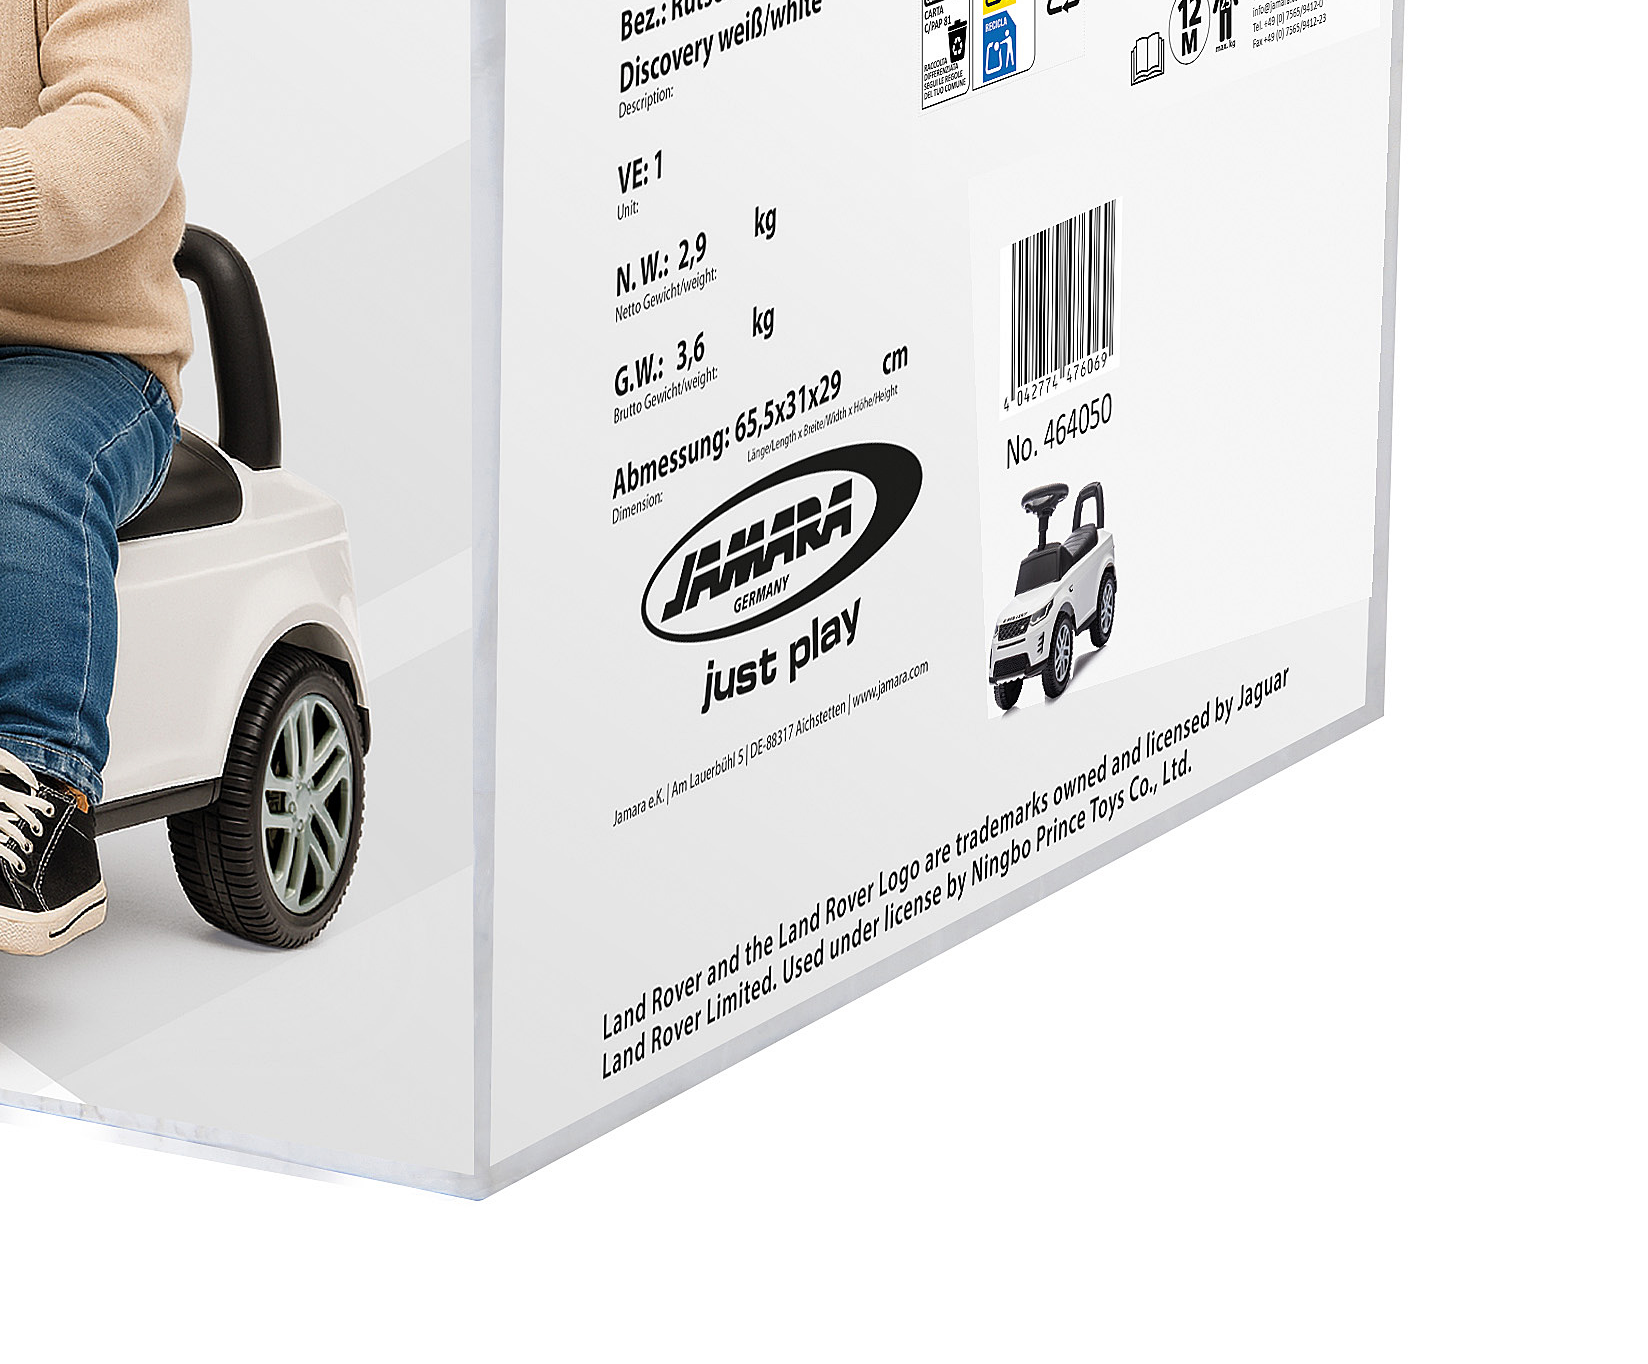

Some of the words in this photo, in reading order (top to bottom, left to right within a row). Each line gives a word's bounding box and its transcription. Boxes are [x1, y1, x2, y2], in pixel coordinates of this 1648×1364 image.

[621, 3, 666, 41] Bez.:
[924, 6, 944, 20] CARTA
[924, 18, 942, 34] C/PAP
[944, 15, 951, 26] 81
[985, 17, 1007, 33] RECICLA
[620, 34, 714, 93] Discovery
[924, 57, 947, 72] RACCOLTA
[1182, 28, 1197, 57] M
[924, 63, 958, 81] DIFFERENZIATA
[924, 91, 932, 100] DEL
[933, 86, 944, 98] TUO
[945, 78, 966, 94] COMUNE
[619, 87, 673, 118] Description:
[618, 157, 648, 194] VE:
[655, 150, 661, 179] 1
[618, 200, 638, 220] Unit:
[617, 263, 636, 297] N.
[641, 250, 668, 285] W.:
[679, 232, 706, 270] 2,9
[754, 206, 777, 240] kg
[616, 302, 641, 323] Netto
[643, 268, 716, 310] Gewicht/weight:
[615, 353, 663, 396] G.W.:
[677, 331, 704, 370] 3,6
[753, 306, 775, 340] kg
[883, 346, 907, 375] cm
[614, 402, 642, 424] Brutto
[644, 367, 717, 409] Gewicht/weight:
[1004, 396, 1009, 412] 4
[1018, 374, 1058, 406] 042774
[1066, 352, 1108, 383] 476069
[613, 427, 729, 499] Abmessung:
[735, 370, 841, 442] 65,5x31x29
[748, 430, 796, 462] Länge/Length
[798, 430, 802, 439] x
[804, 407, 846, 436] Breite/Width
[848, 407, 852, 416] x
[854, 385, 897, 413] Höhe/Height
[1007, 435, 1037, 469] No.
[1044, 394, 1112, 449] 464050
[613, 492, 663, 524] Dimension:
[660, 478, 853, 623] JAMARA
[734, 574, 789, 613] GERMANY
[701, 649, 776, 714] just
[790, 597, 861, 683] play
[613, 801, 646, 827] Jamara
[649, 788, 664, 808] e.K.
[672, 780, 687, 797] Am
[690, 751, 735, 788] Lauerbühl
[738, 748, 743, 765] 5
[751, 724, 793, 758] DE-88317
[796, 702, 845, 736] Aichstetten
[853, 661, 928, 708] www.jamara.com
[604, 993, 645, 1040] Land
[653, 971, 702, 1015] Rover
[708, 944, 739, 986] and
[745, 935, 773, 966] the
[779, 903, 819, 949] Land
[826, 882, 874, 924] Rover
[880, 860, 919, 897] Logo
[925, 844, 950, 873] are
[956, 793, 1048, 856] trademarks
[1054, 757, 1106, 805] owned
[1112, 739, 1140, 775] and
[1147, 704, 1209, 758] licensed
[1215, 696, 1233, 724] by
[1237, 667, 1289, 711] Jaguar
[603, 1032, 645, 1079] Land
[652, 1010, 701, 1054] Rover
[707, 966, 776, 1024] Limited.
[784, 939, 824, 983] Used
[830, 917, 879, 959] under
[885, 886, 941, 931] license
[947, 872, 966, 901] by
[972, 839, 1031, 886] Ningbo
[1037, 810, 1085, 852] Prince
[1090, 790, 1124, 823] Toys
[1130, 776, 1157, 801] Co.,
[1163, 751, 1191, 786] Ltd.
